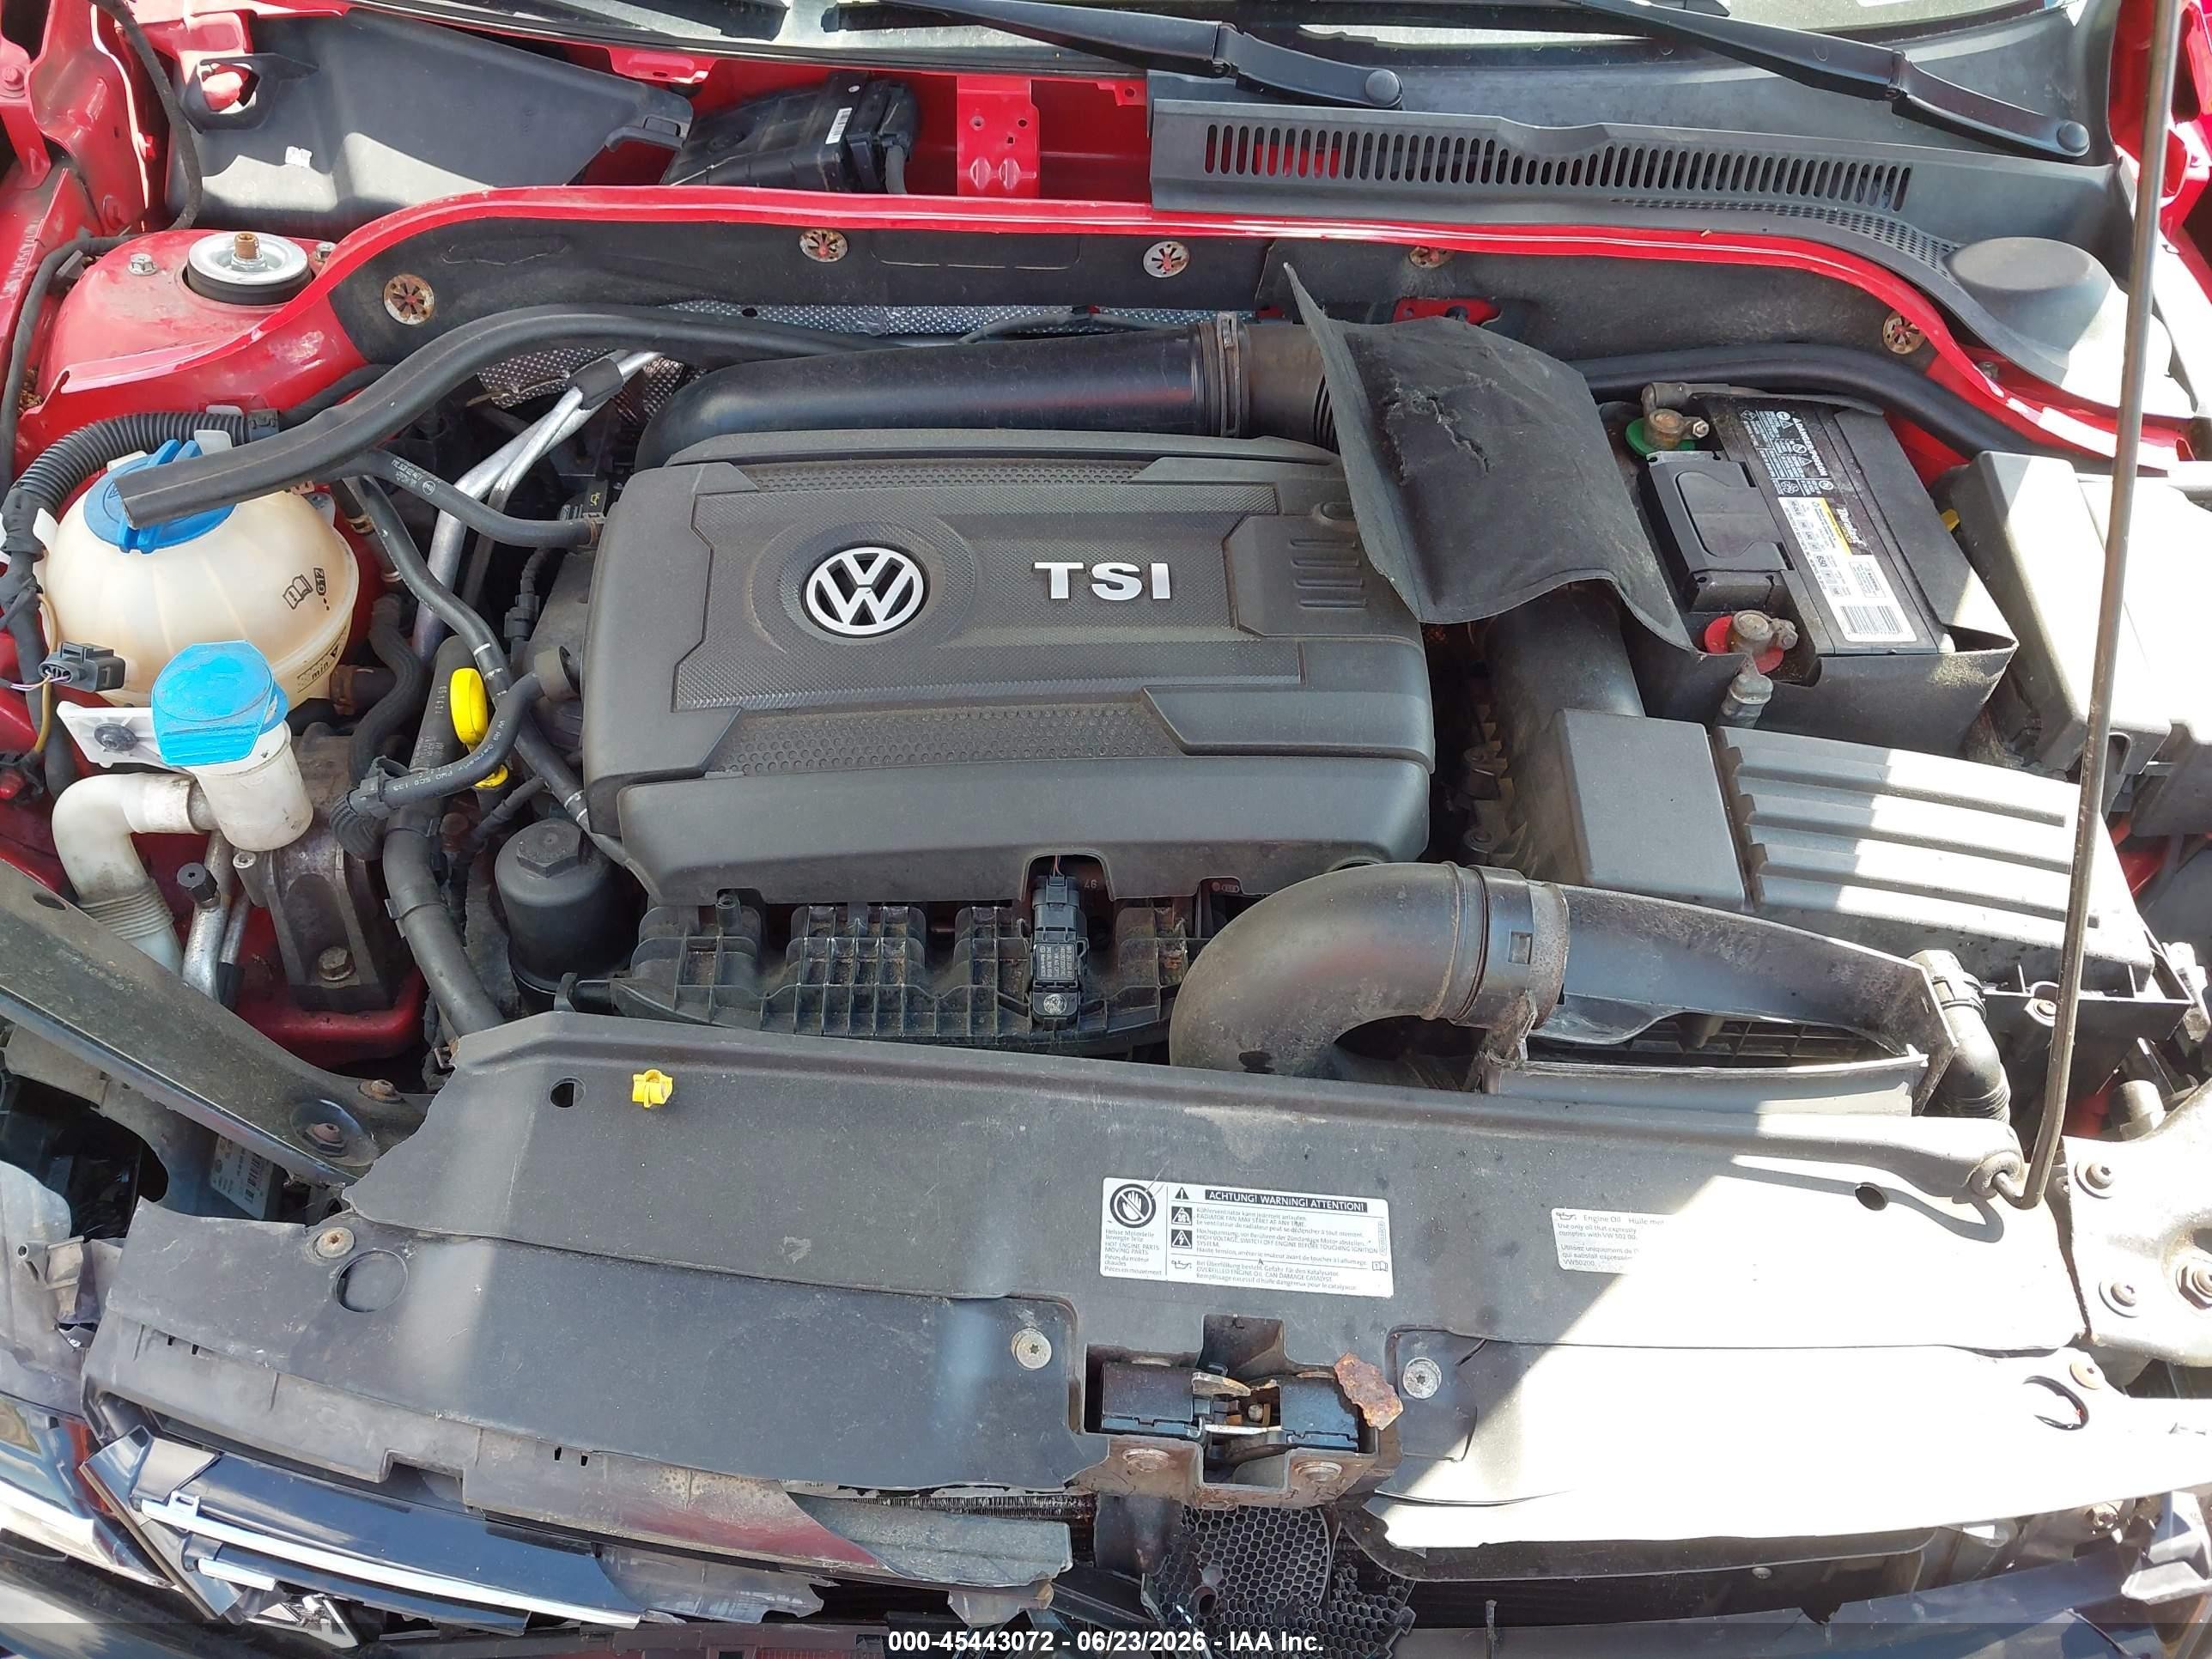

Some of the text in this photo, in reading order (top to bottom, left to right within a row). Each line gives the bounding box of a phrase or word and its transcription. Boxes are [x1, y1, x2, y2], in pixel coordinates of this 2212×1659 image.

[1836, 507, 1868, 549] Duralast
[314, 568, 326, 595] G12
[1034, 562, 1172, 601] TSI
[311, 660, 329, 679] min
[1209, 1191, 1364, 1212] ACHTUNG! WARNING! ATTENTION!
[1583, 1215, 1608, 1224] Engine
